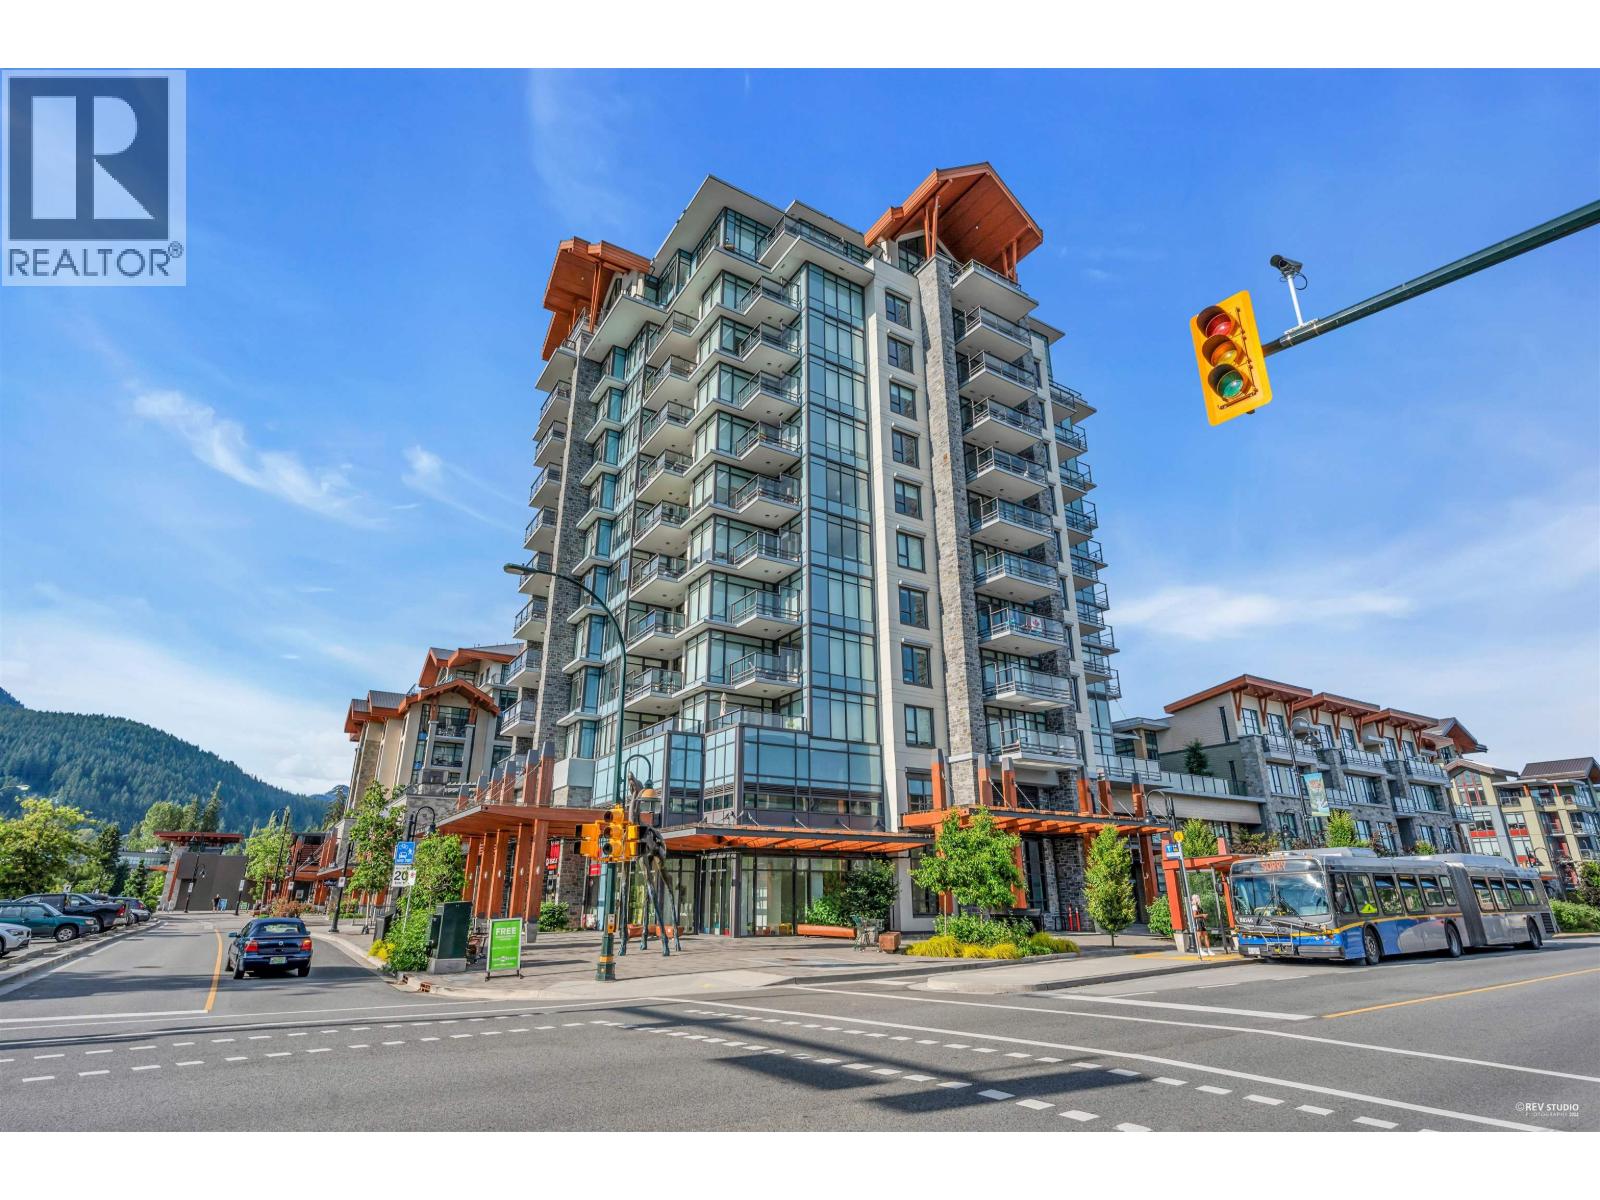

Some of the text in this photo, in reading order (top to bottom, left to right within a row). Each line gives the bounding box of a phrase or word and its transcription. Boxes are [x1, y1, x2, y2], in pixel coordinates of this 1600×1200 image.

[1260, 861, 1287, 871] SORRY
[393, 870, 409, 881] 20
[495, 926, 518, 936] FREE
